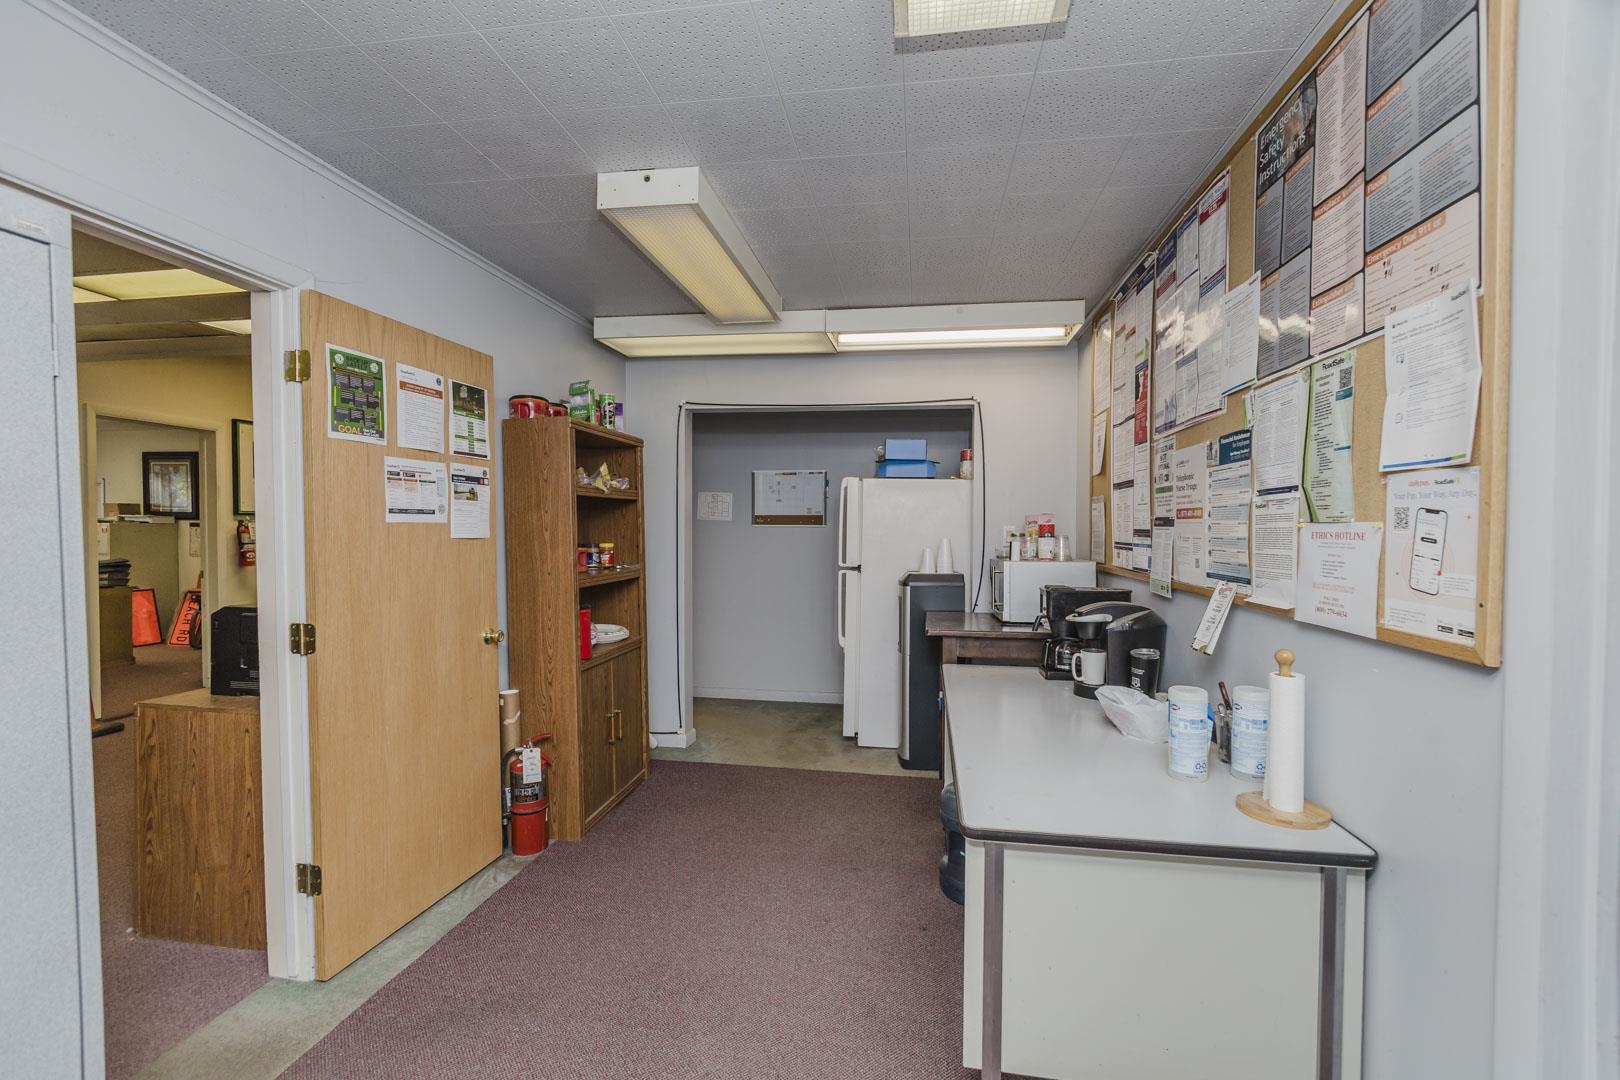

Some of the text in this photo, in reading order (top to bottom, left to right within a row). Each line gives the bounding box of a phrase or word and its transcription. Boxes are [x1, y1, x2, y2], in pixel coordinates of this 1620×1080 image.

[1260, 97, 1303, 148] Emergency
[1259, 131, 1306, 184] Instructions
[1260, 136, 1284, 167] Safety
[1367, 240, 1403, 264] Emergency
[1417, 223, 1432, 237] 911
[1322, 358, 1345, 371] RoadSafe
[338, 424, 362, 435] GOAL
[1311, 531, 1366, 541] ETHICS HOTLINE
